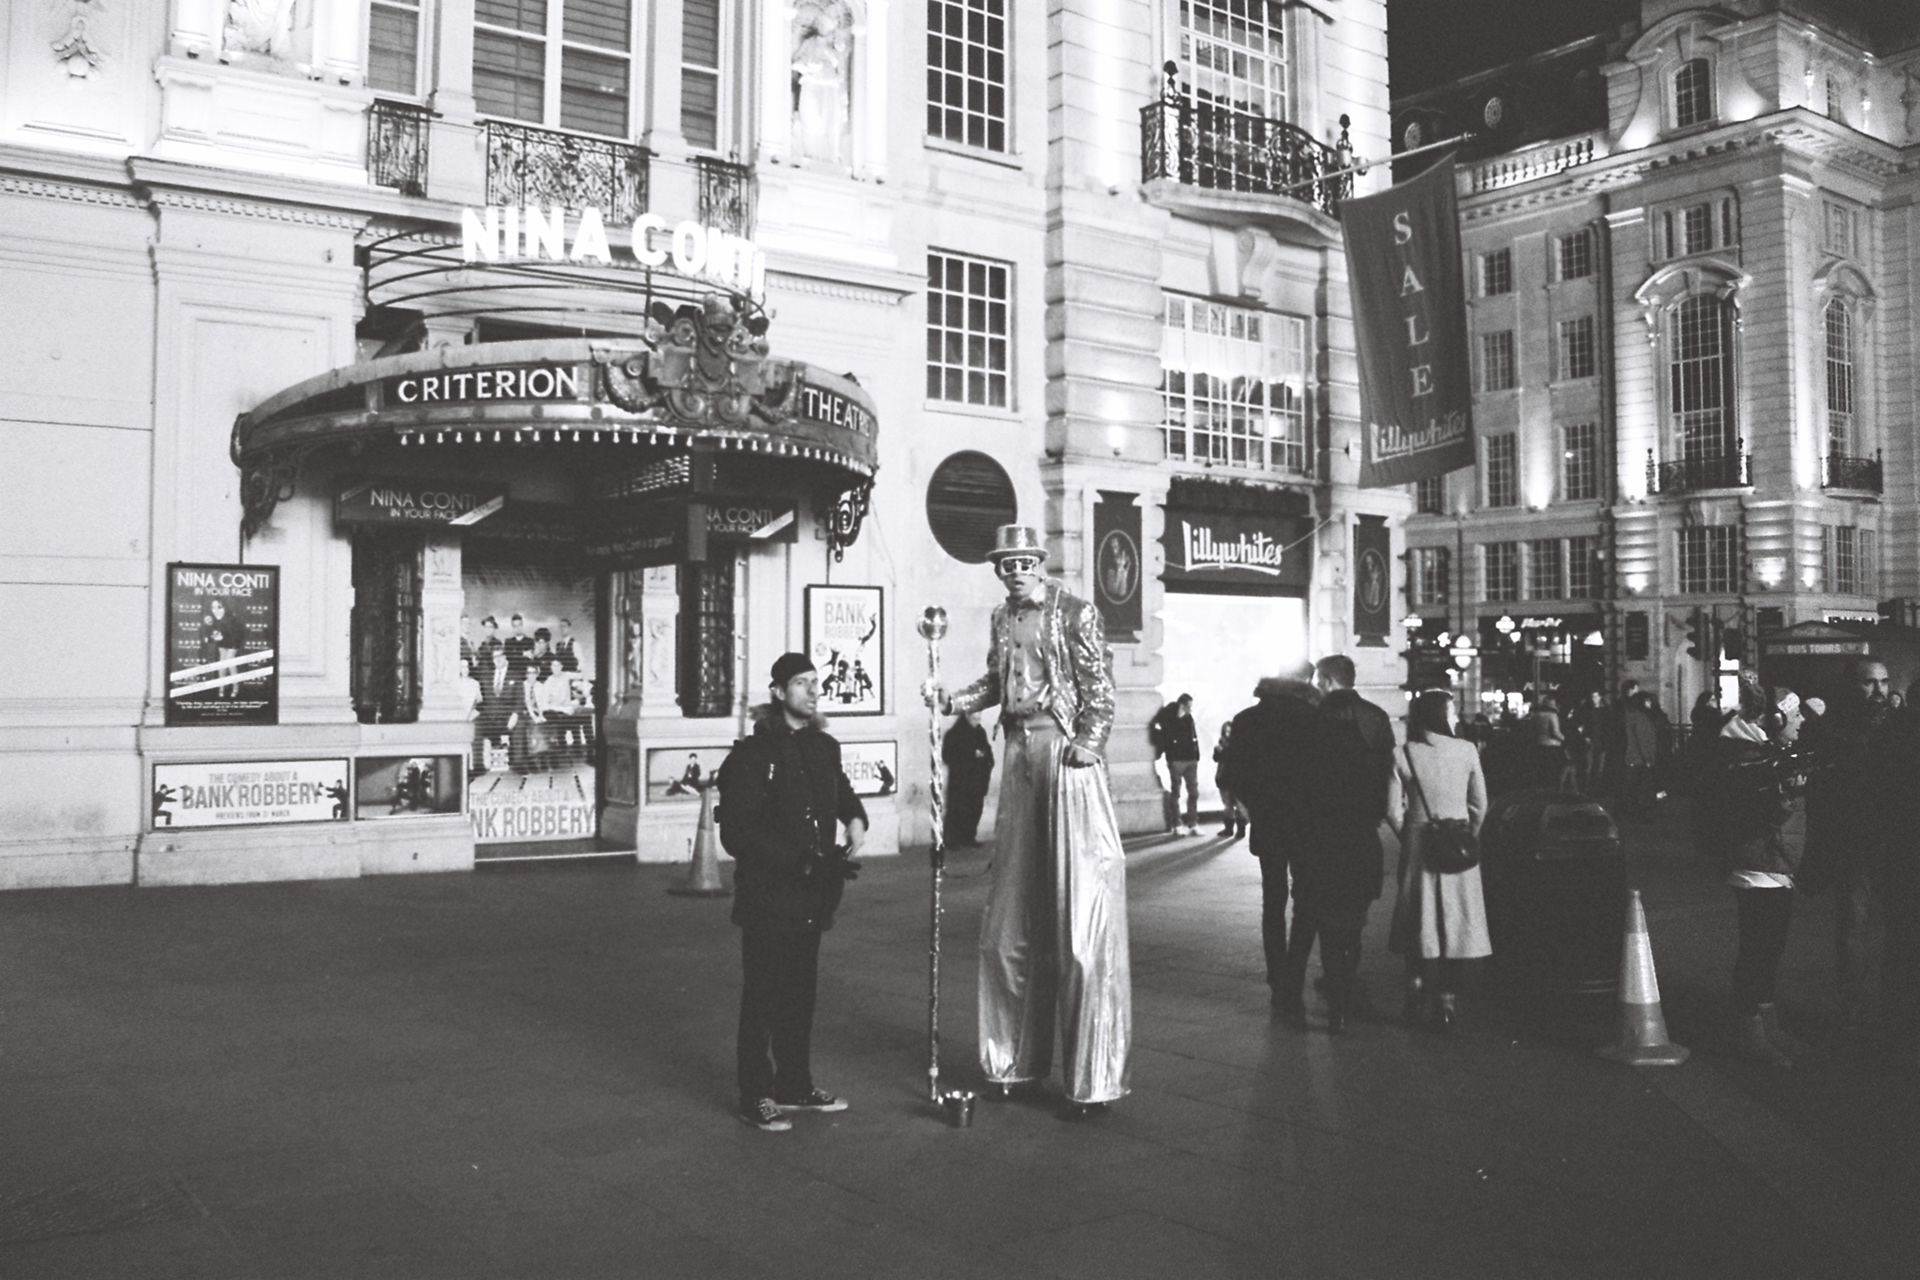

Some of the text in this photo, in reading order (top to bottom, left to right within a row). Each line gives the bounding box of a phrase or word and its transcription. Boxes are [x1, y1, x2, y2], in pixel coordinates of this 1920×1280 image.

[461, 205, 765, 296] NINA CONTI
[1393, 211, 1434, 398] SALE
[397, 366, 577, 403] CRITERION
[1370, 411, 1466, 463] Lillywhites
[370, 489, 414, 508] NINA
[420, 491, 478, 512] CONTI
[404, 509, 431, 519] YOUR
[434, 511, 459, 521] FACE
[726, 508, 773, 525] CONTI
[713, 523, 736, 533] YOUR
[1182, 520, 1283, 576] Lillywhites
[177, 571, 269, 589] NINA CONTI
[206, 587, 230, 596] YOUR
[231, 588, 252, 597] FACE
[825, 602, 866, 624] BANK
[209, 770, 298, 784] THE COMEDY ABOUT A
[845, 761, 876, 780] BERY
[181, 782, 319, 809] BANK ROBBERY
[470, 804, 594, 838] NK ROBBERY
